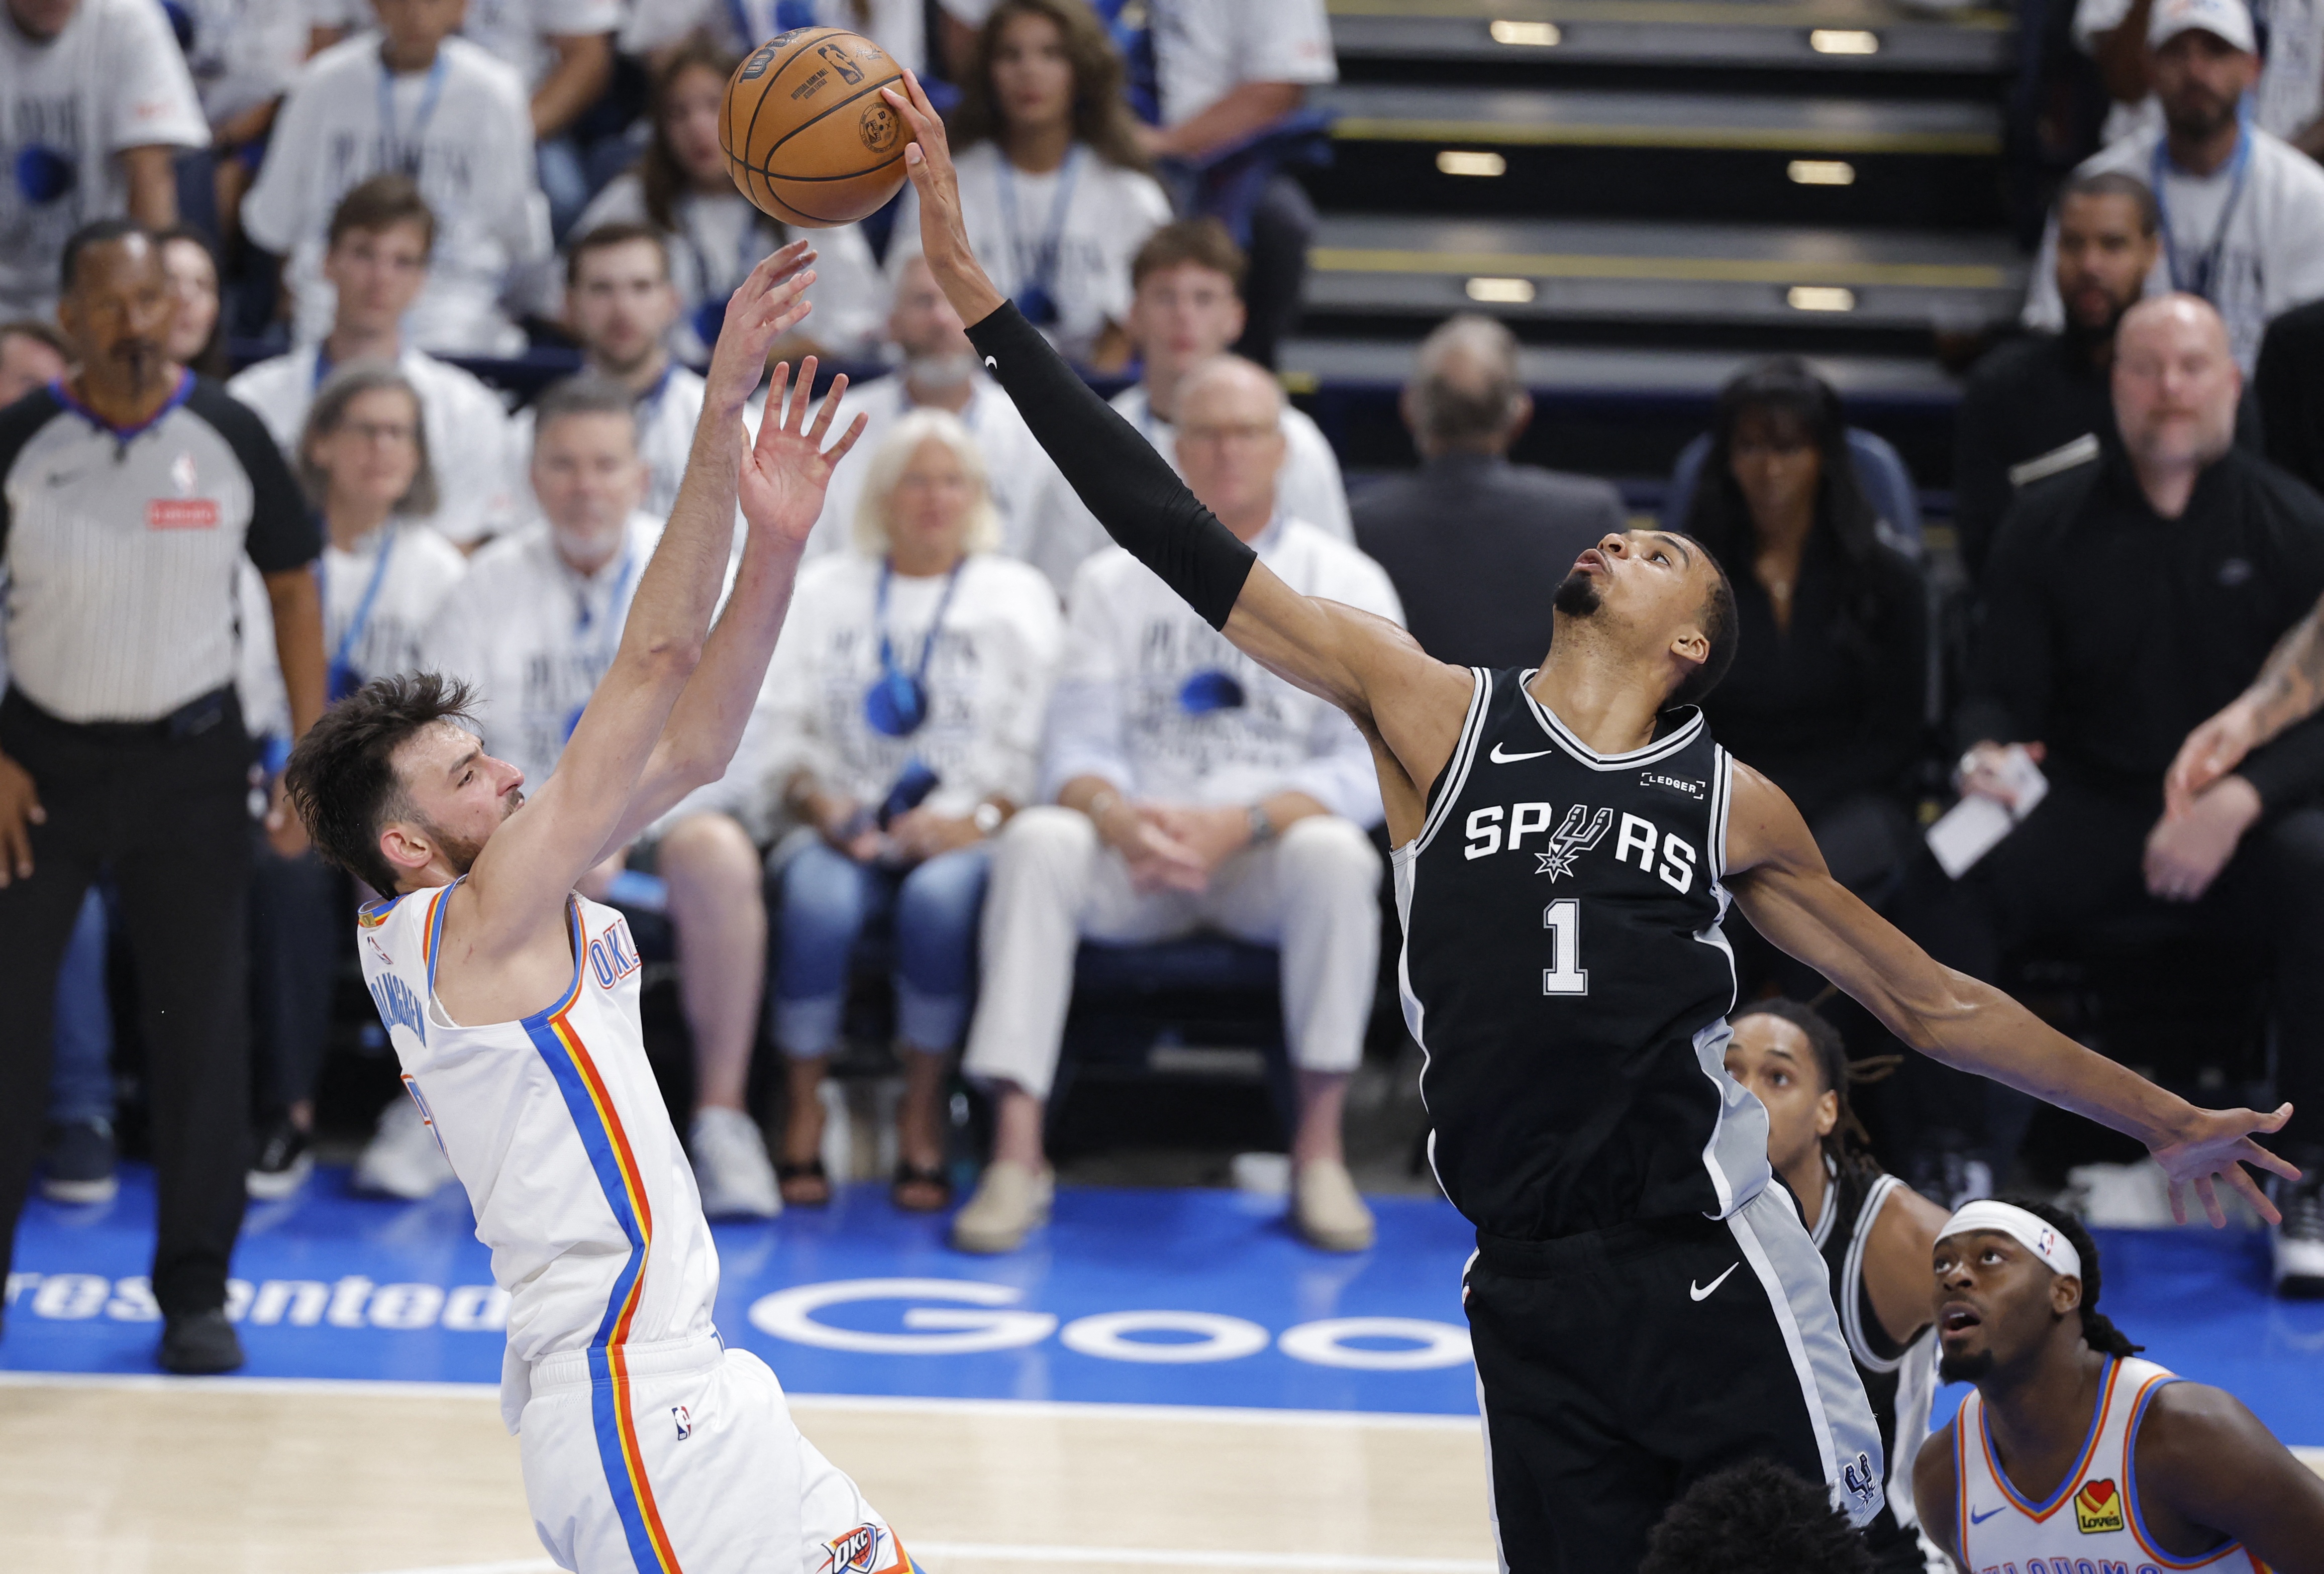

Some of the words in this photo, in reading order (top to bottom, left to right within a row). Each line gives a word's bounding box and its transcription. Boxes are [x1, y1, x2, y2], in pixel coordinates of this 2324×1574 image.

[1649, 775, 1697, 793] LEDGER
[1464, 802, 1696, 895] SPURS
[1543, 898, 1588, 996] 1
[370, 972, 427, 1049] OLMGREN
[833, 1528, 868, 1574] OKC
